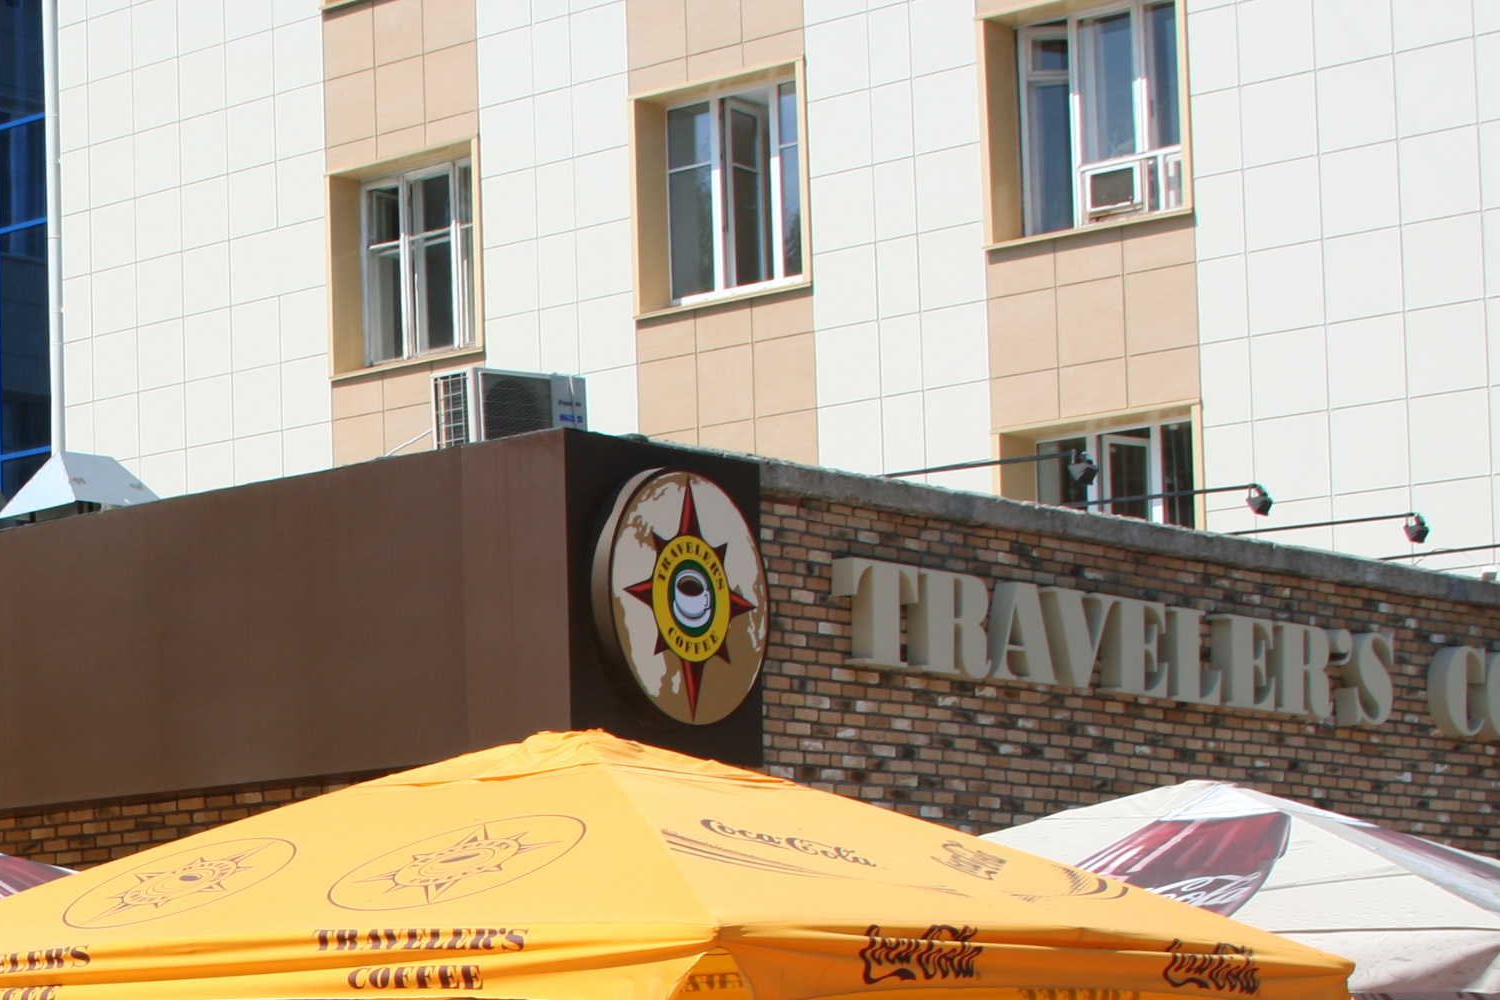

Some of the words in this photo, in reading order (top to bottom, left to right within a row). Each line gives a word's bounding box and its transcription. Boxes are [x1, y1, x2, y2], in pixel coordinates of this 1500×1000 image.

[657, 541, 725, 591] TRAVELER'S
[668, 627, 719, 654] COFFEE
[831, 556, 1395, 727] TRAVELER'S
[311, 928, 528, 951] TRAVELER'S
[347, 965, 483, 990] COFFEE
